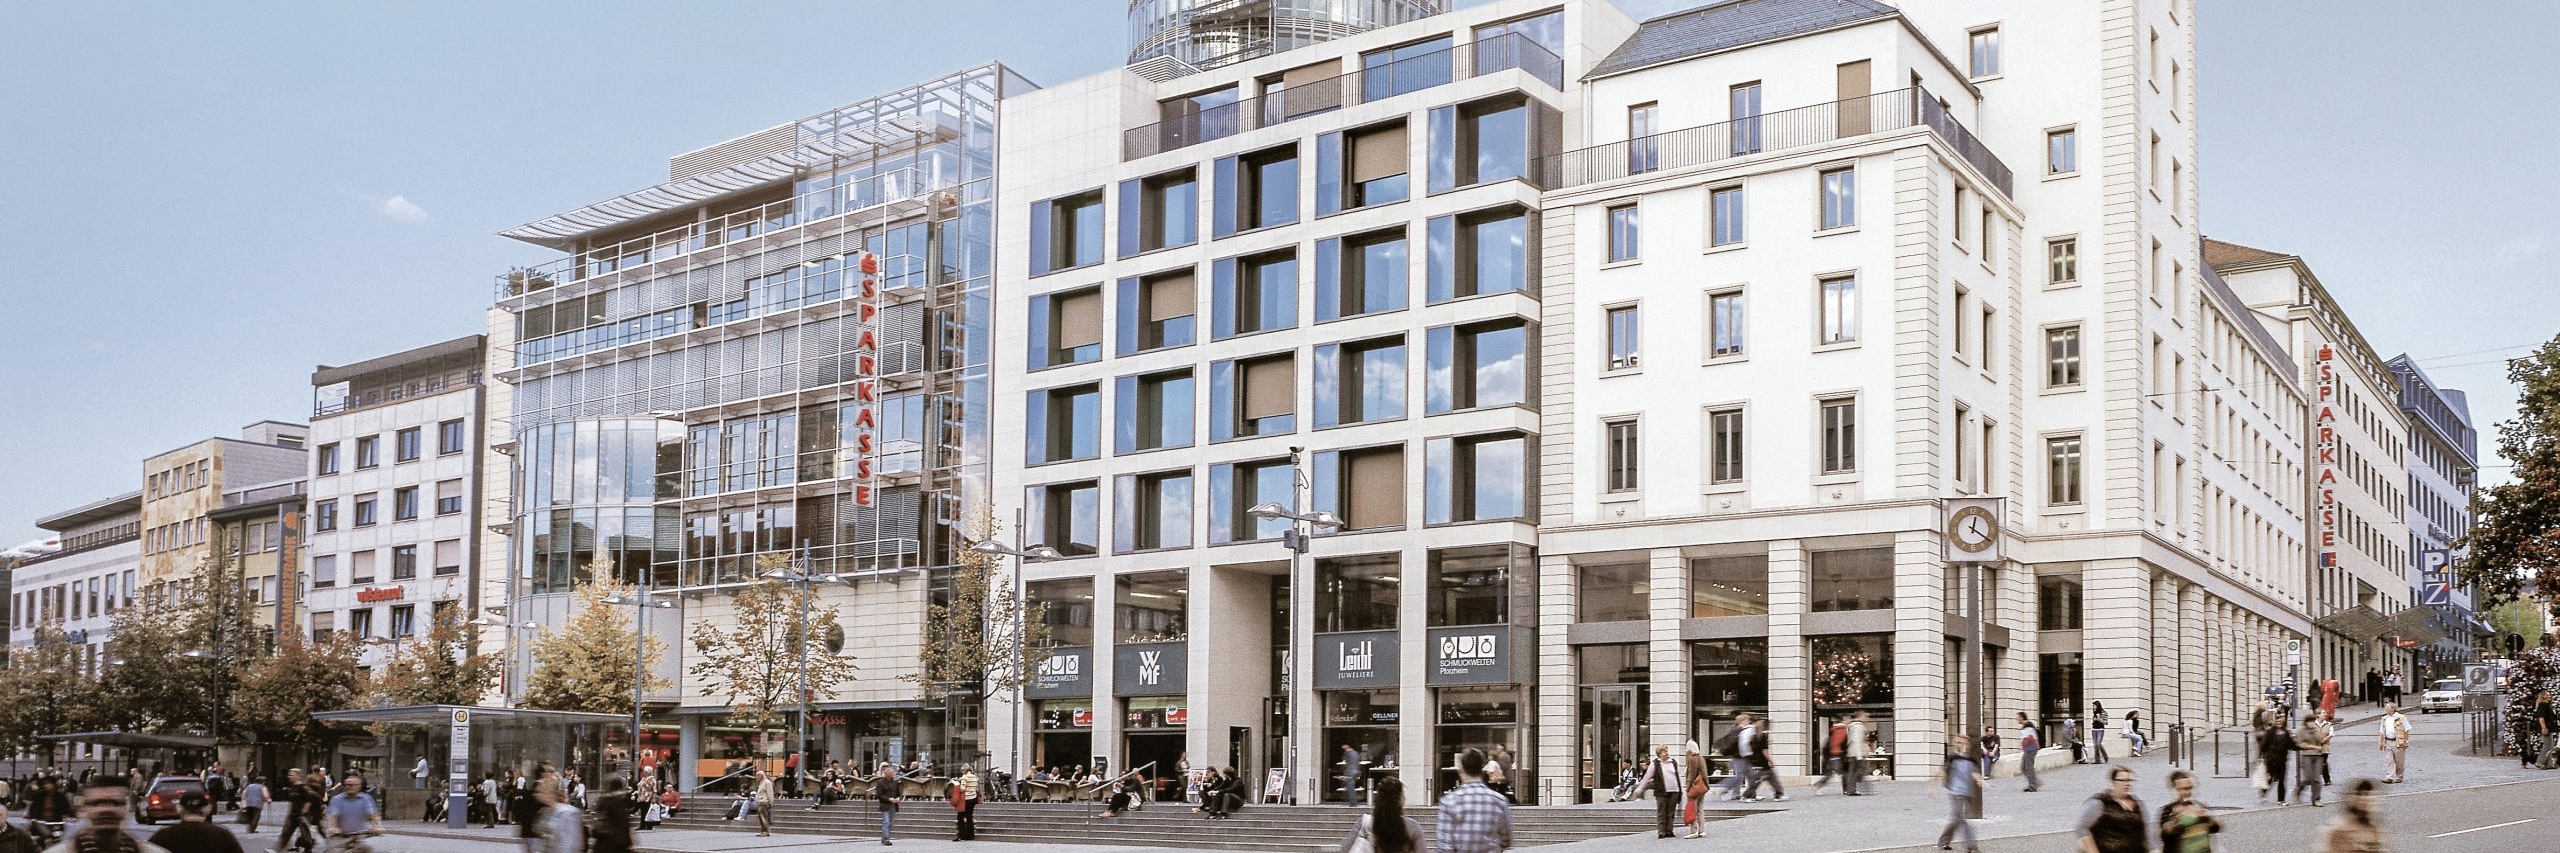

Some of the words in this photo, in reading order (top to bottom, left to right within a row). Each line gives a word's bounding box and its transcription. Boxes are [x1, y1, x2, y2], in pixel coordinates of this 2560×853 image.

[857, 279, 876, 505] SPARKASSE
[2317, 364, 2336, 547] SPARKASSE
[281, 535, 297, 640] COMMERZBANK
[1338, 671, 1374, 679] JUWELIERE
[1440, 659, 1495, 667] SCHMUCKWELTEN
